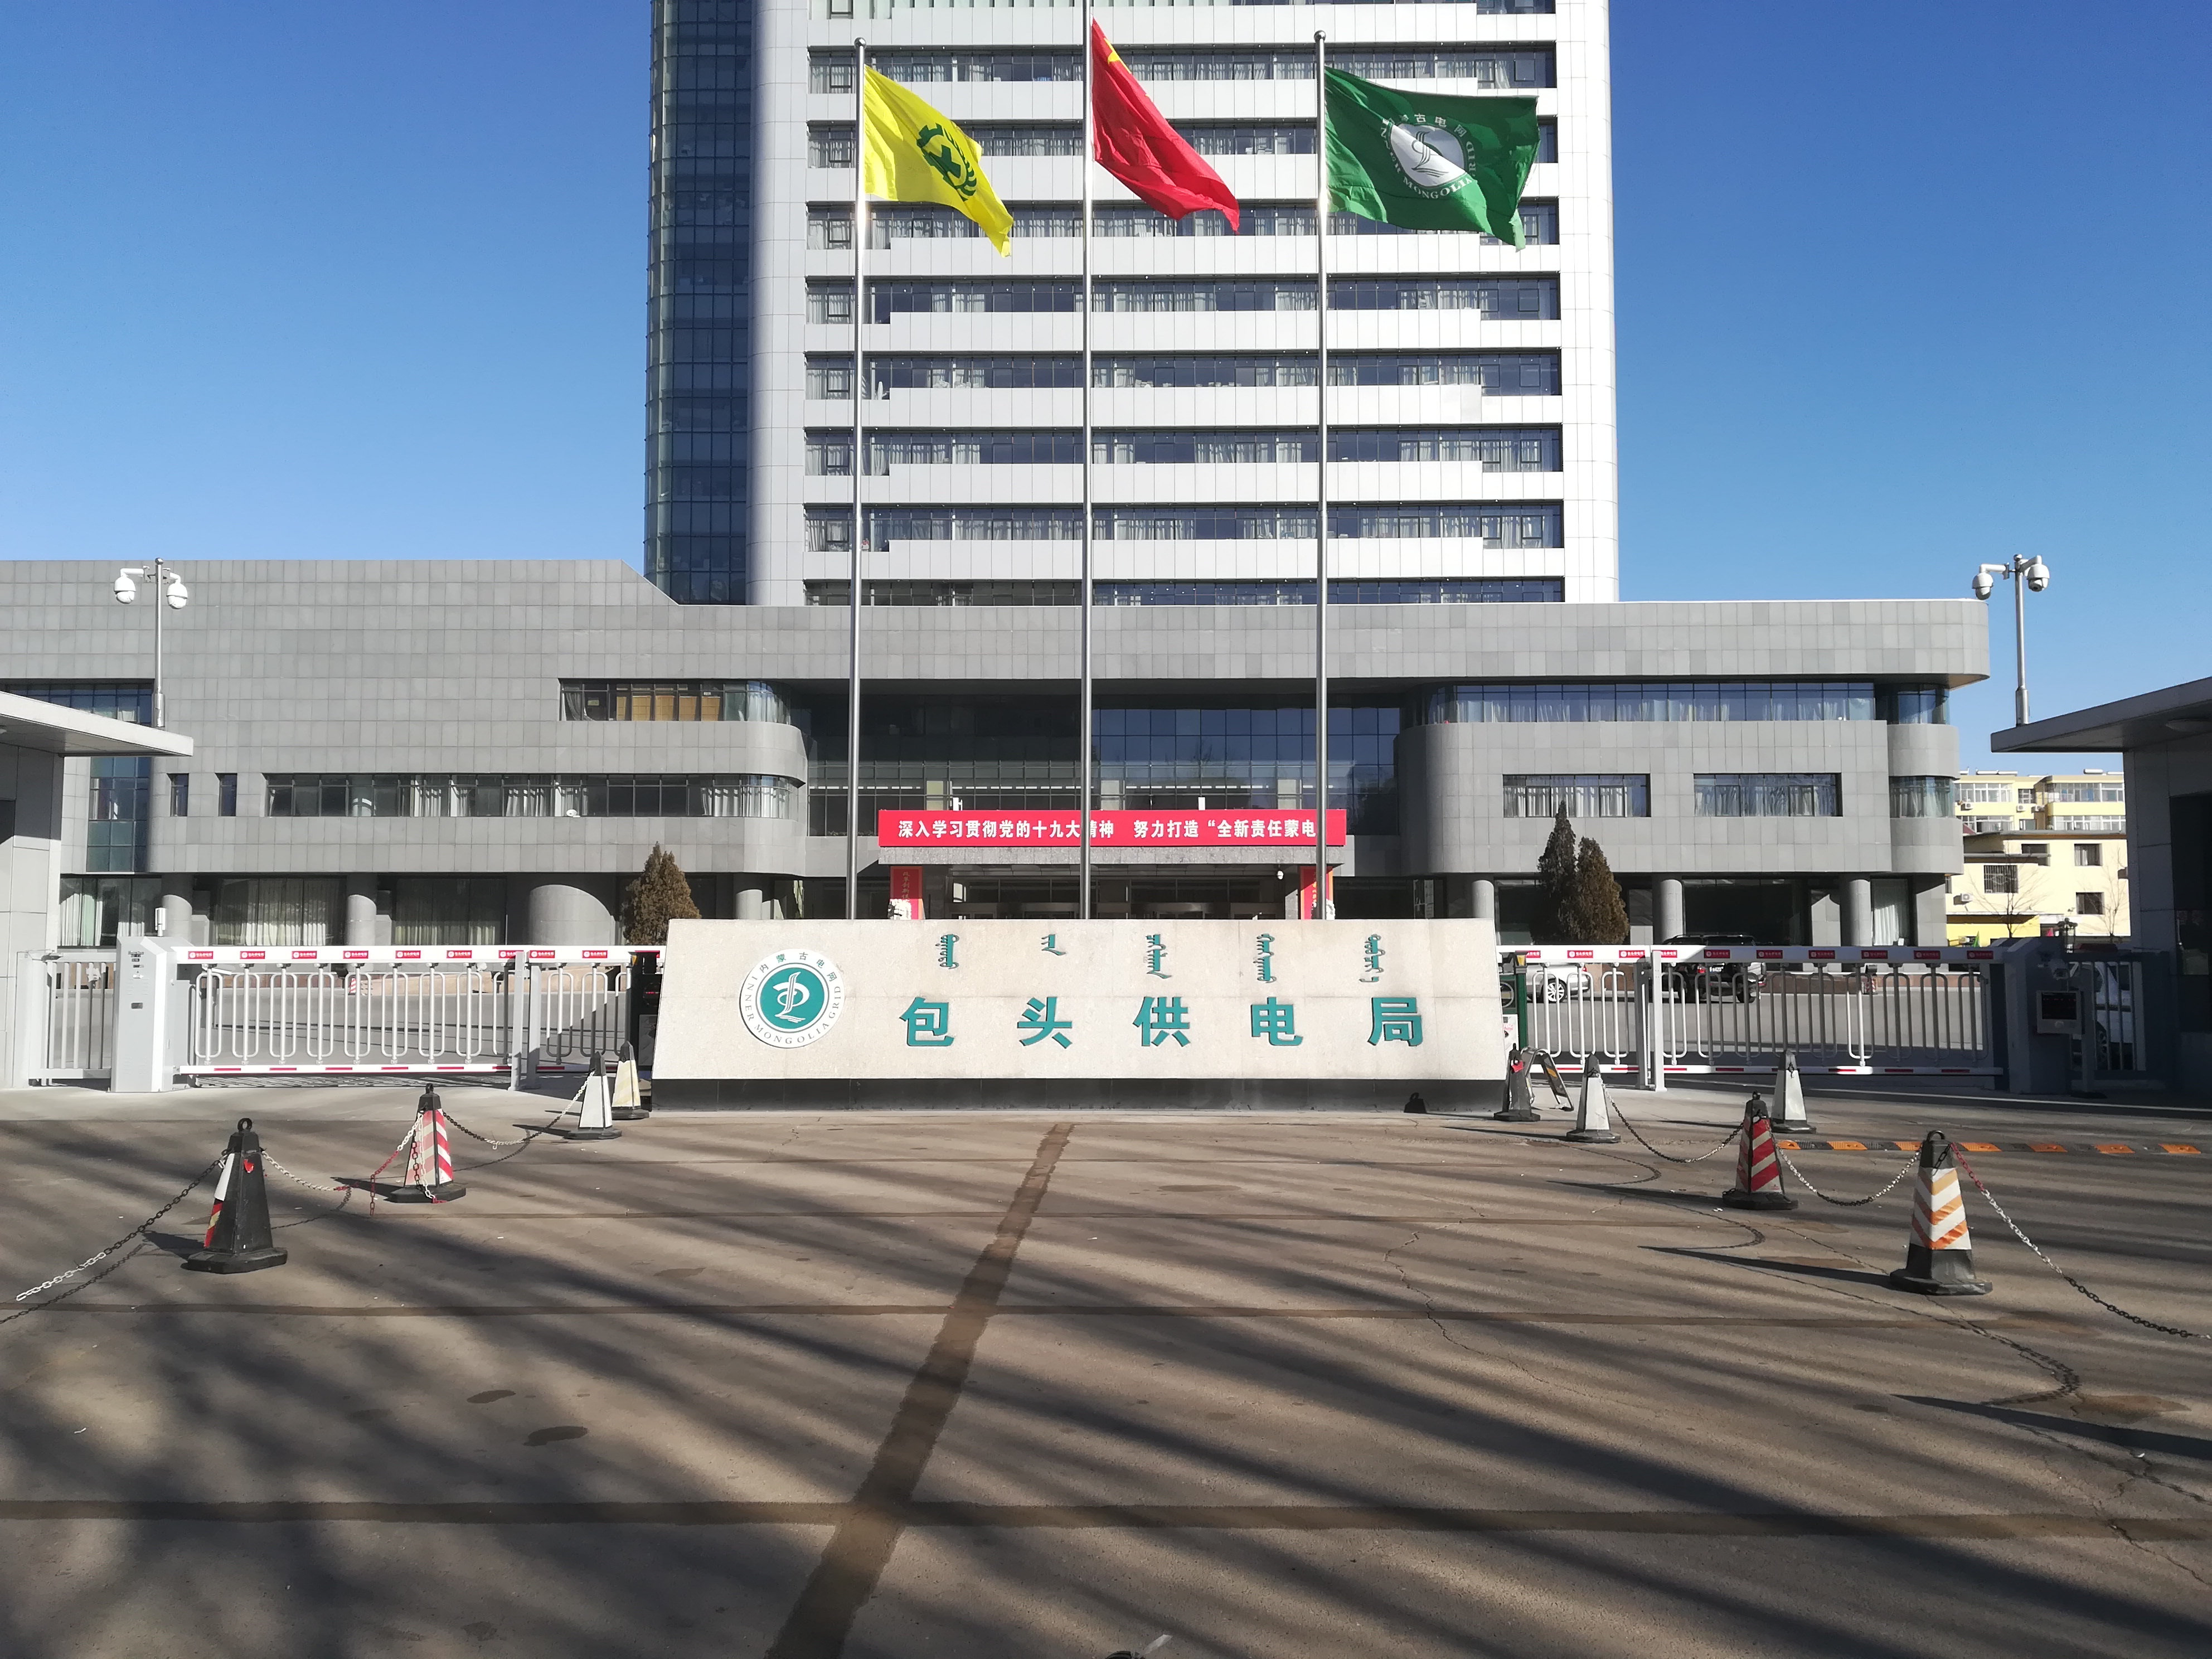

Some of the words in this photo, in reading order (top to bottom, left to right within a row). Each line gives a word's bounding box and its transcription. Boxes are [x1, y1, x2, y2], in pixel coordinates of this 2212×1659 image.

[1403, 176, 1473, 200] MONGOLIA
[1466, 140, 1477, 177] RID
[745, 975, 759, 1022] INNER
[754, 1021, 830, 1044] MONGOLIA
[828, 986, 842, 1020] GRID
[899, 996, 1423, 1049] 包头供电局
